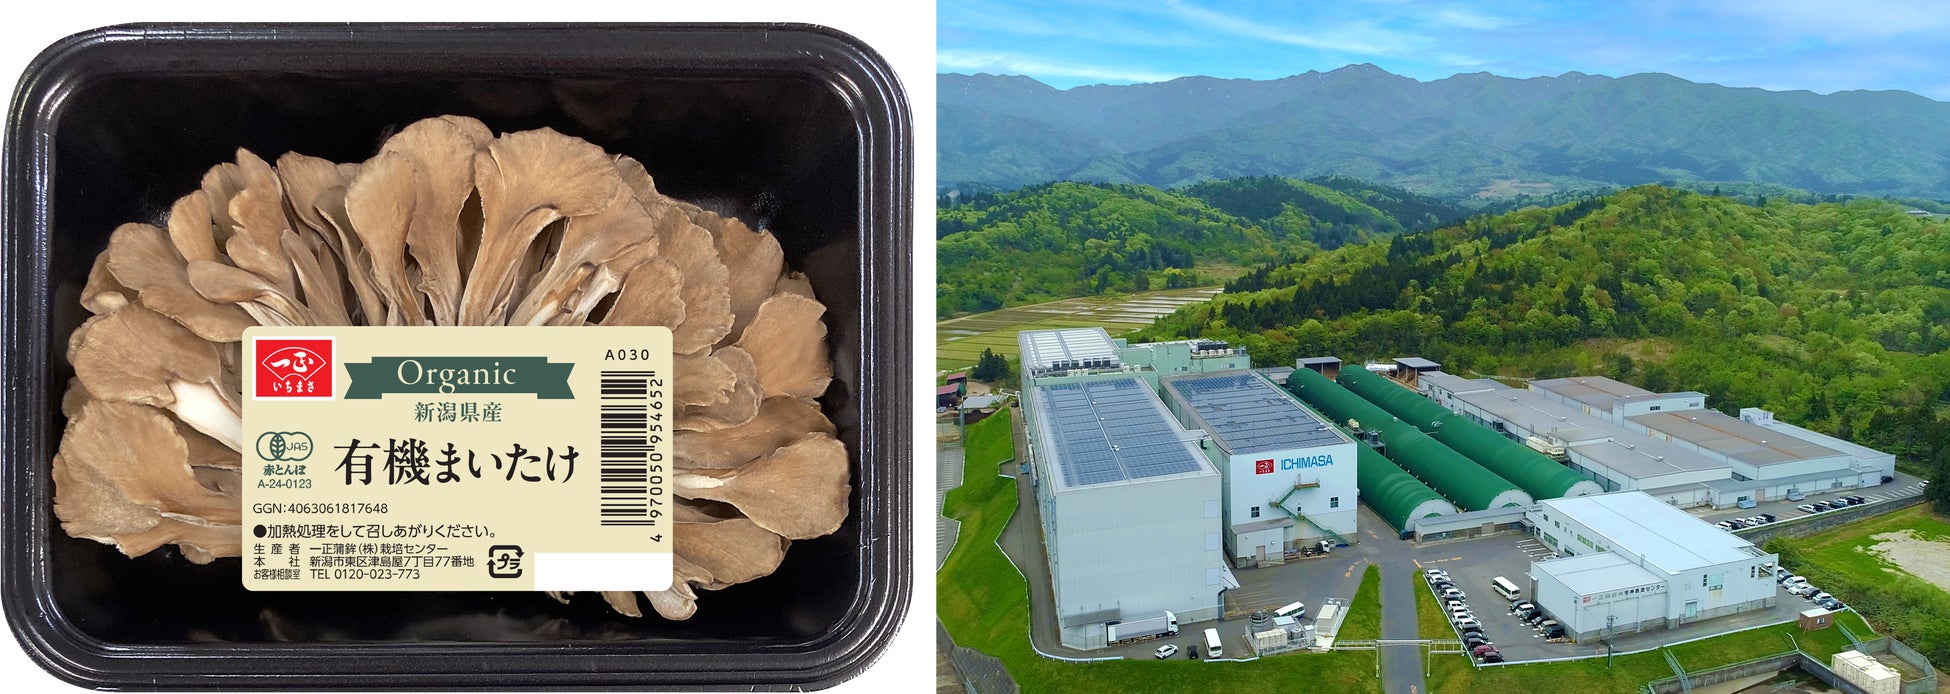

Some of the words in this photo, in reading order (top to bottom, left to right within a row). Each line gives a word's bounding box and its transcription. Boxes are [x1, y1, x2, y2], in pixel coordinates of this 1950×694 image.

[397, 359, 516, 394] Organic
[273, 380, 315, 393] いちまさ
[414, 401, 503, 423] 新潟県産
[286, 442, 308, 451] JAS
[333, 438, 579, 486] 有機まいたけ
[1281, 454, 1334, 470] ICHIMASA
[257, 479, 312, 489] A-24-0123
[497, 553, 521, 570] プラ
[253, 568, 300, 580] お客様相談室
[310, 569, 331, 579] TEL
[334, 569, 420, 580] 0120-023-773
